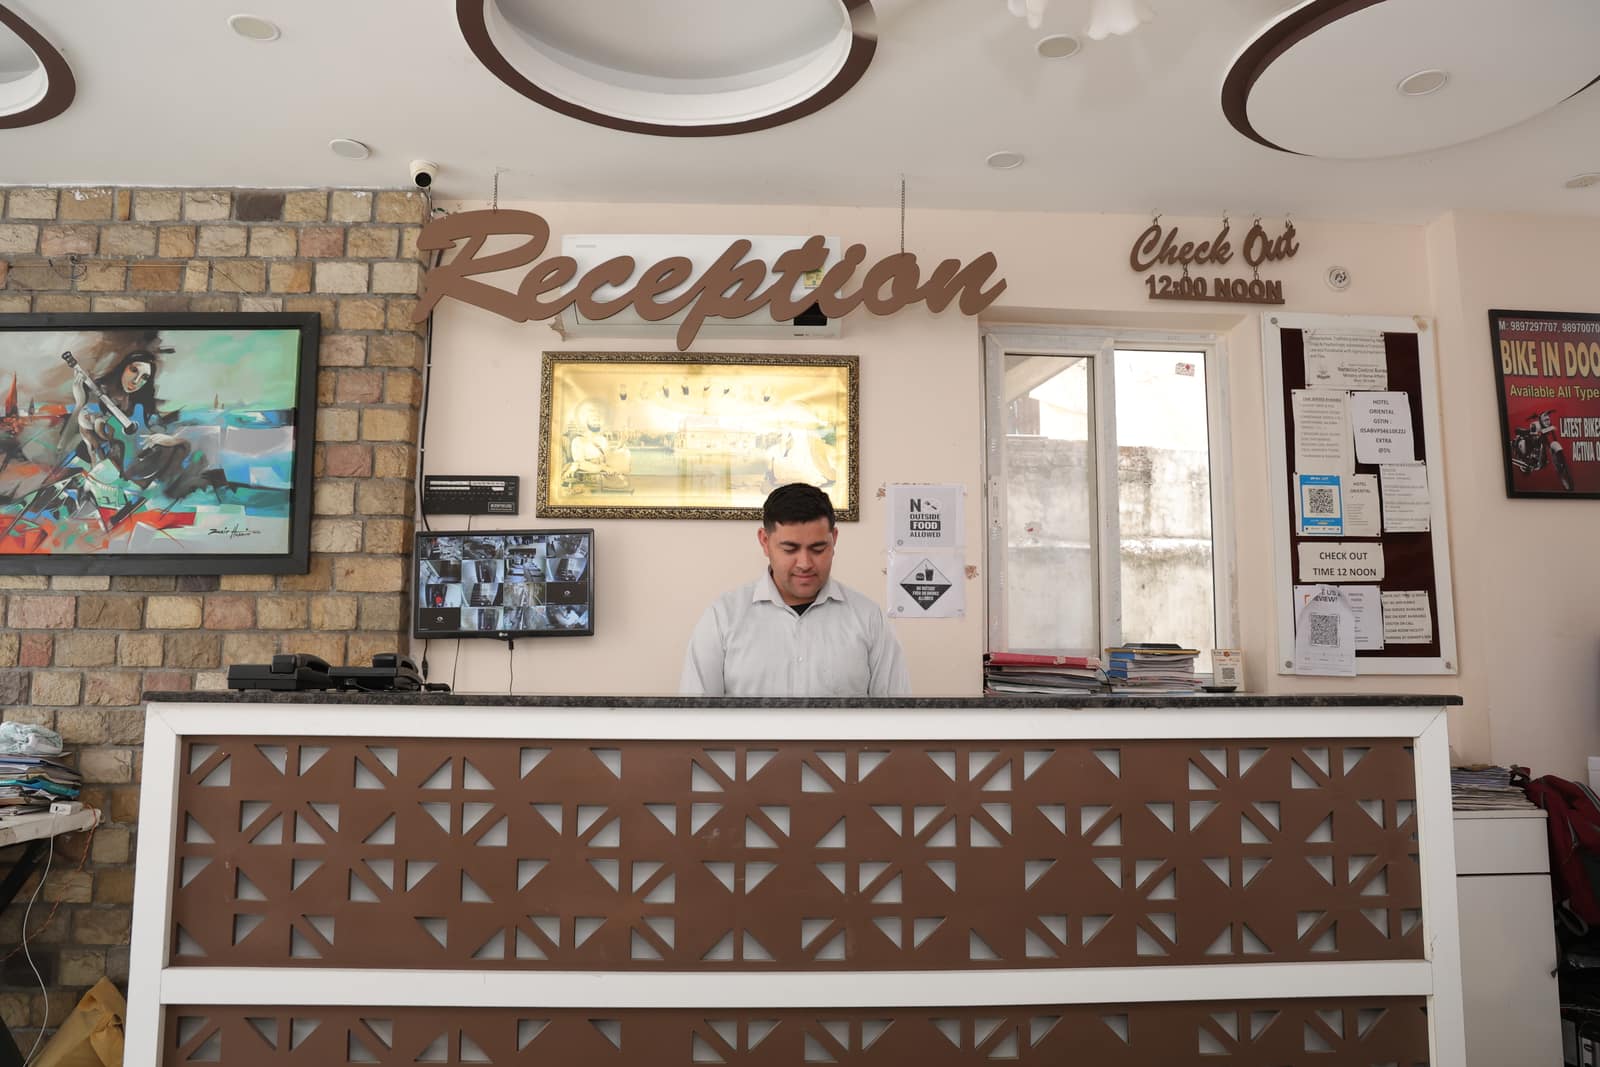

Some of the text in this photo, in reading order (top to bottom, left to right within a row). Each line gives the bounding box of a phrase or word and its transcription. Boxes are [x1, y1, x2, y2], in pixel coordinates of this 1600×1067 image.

[1130, 224, 1300, 272] Check Out
[414, 208, 1008, 351] Reception
[1145, 274, 1283, 299] 12:00 NOON
[1500, 339, 1539, 376] BIKE
[1540, 341, 1561, 377] IN
[1510, 384, 1555, 398] Available
[1557, 385, 1571, 398] All
[1560, 417, 1582, 438] LATEST
[1572, 441, 1595, 462] ACTIVA
[912, 521, 938, 529] FOOD
[1319, 551, 1368, 560] CHECK OUT
[1312, 567, 1377, 576] TIME 12 NOON
